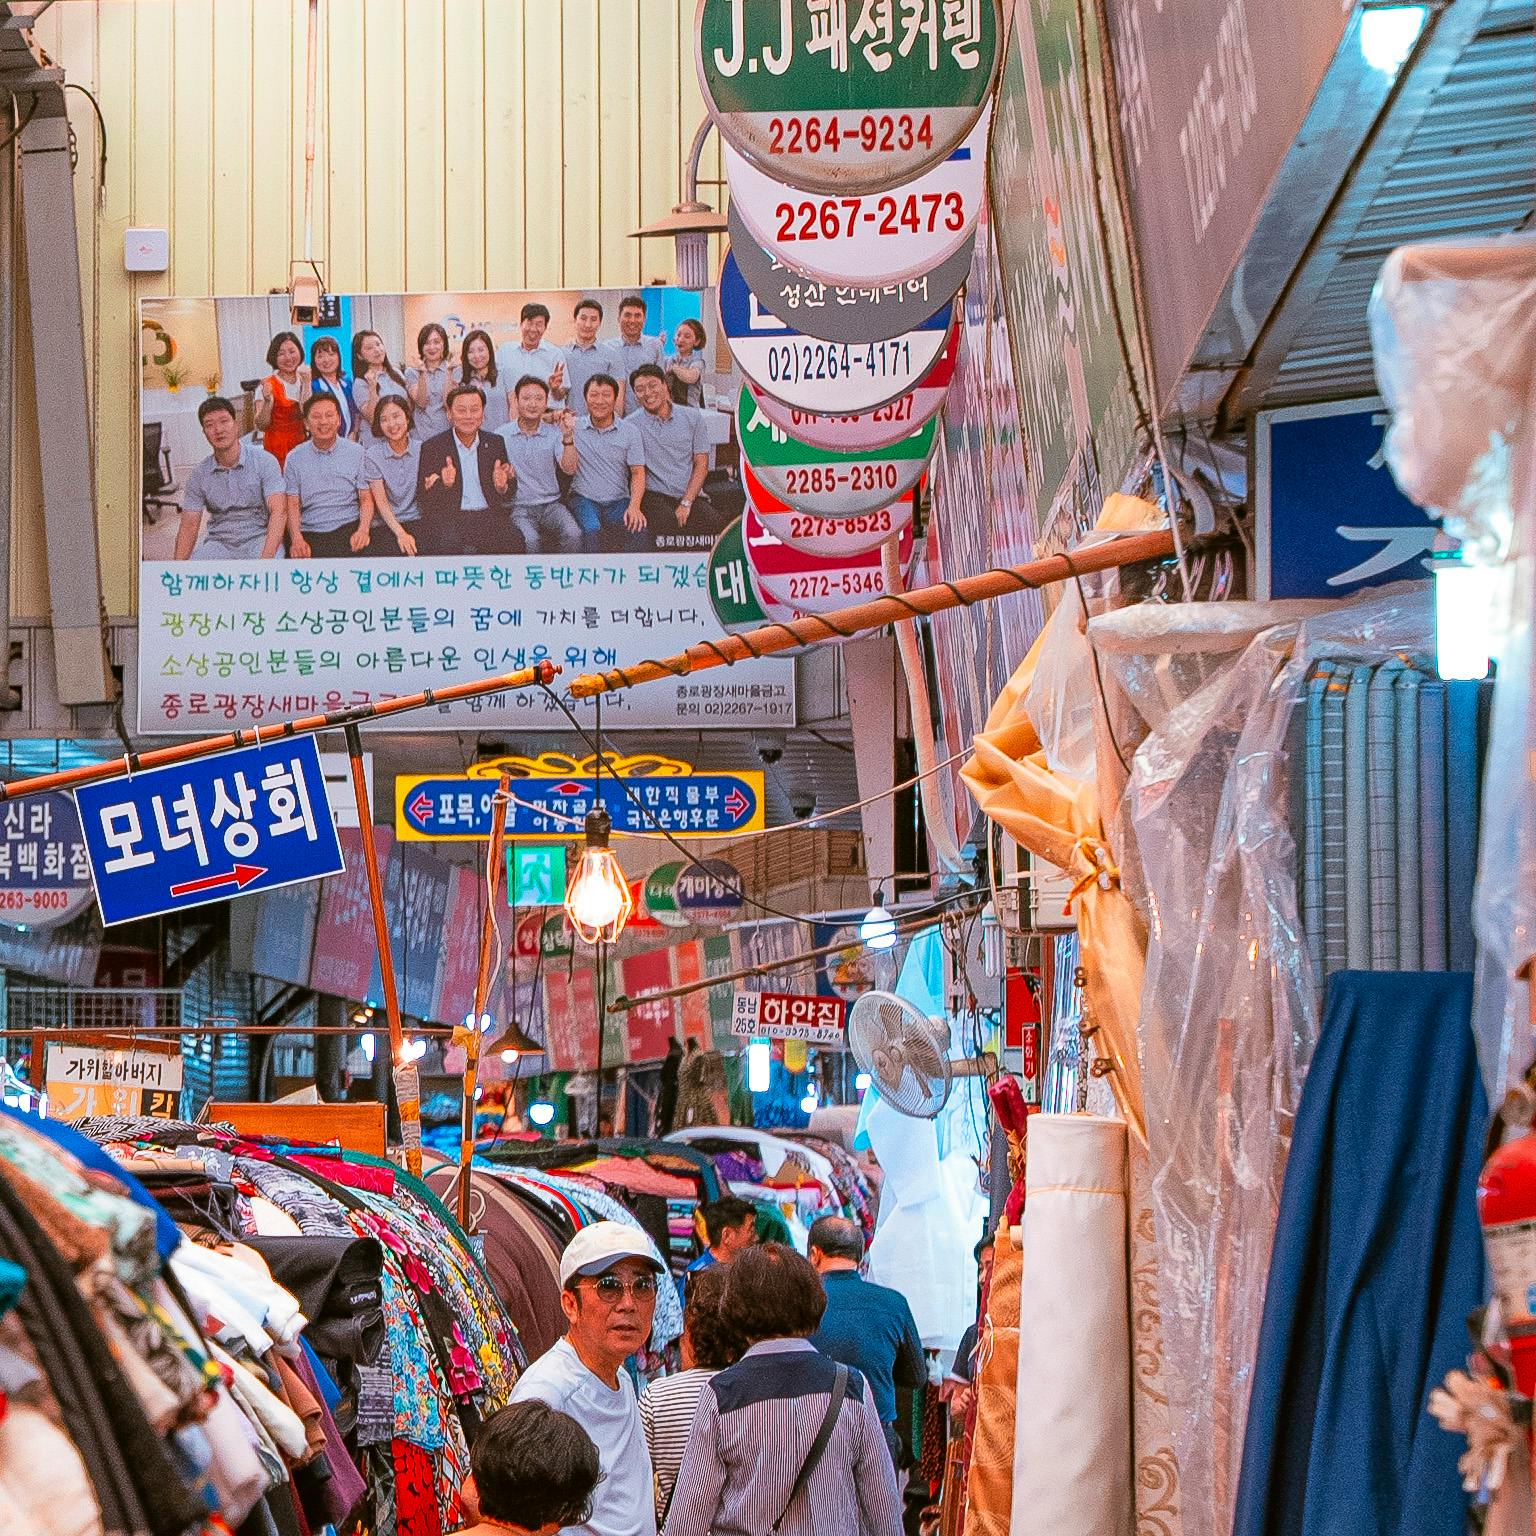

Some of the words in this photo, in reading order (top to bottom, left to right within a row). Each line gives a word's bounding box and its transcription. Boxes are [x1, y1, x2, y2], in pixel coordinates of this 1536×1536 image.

[768, 114, 934, 155] 2264-9234
[775, 191, 965, 242] 2267-2473
[768, 341, 911, 384] 02)2264-4171
[786, 463, 898, 495] 2285-2310
[790, 510, 892, 539] 2273-8523
[290, 567, 339, 594] 항상
[350, 568, 424, 594] 곁에서
[435, 563, 513, 591] 따뜻한
[524, 563, 627, 591] 동반자가
[714, 559, 750, 605] 대
[789, 571, 884, 600] 2272-5346
[160, 610, 265, 637] 광장시장
[275, 606, 455, 635] 소상공인분들의
[470, 606, 522, 631] 꿈에
[536, 606, 600, 629] 가치를
[159, 648, 341, 678] 소상공인분들의
[356, 645, 462, 673] 아름다운
[564, 644, 618, 668] 위해
[676, 683, 786, 699] 종로광장새마을금고
[676, 702, 700, 716] 문의
[3, 802, 53, 841] 신라
[99, 757, 318, 875] 모녀상회
[763, 997, 841, 1029] 하얀집
[65, 1058, 162, 1086] 가위할아버지
